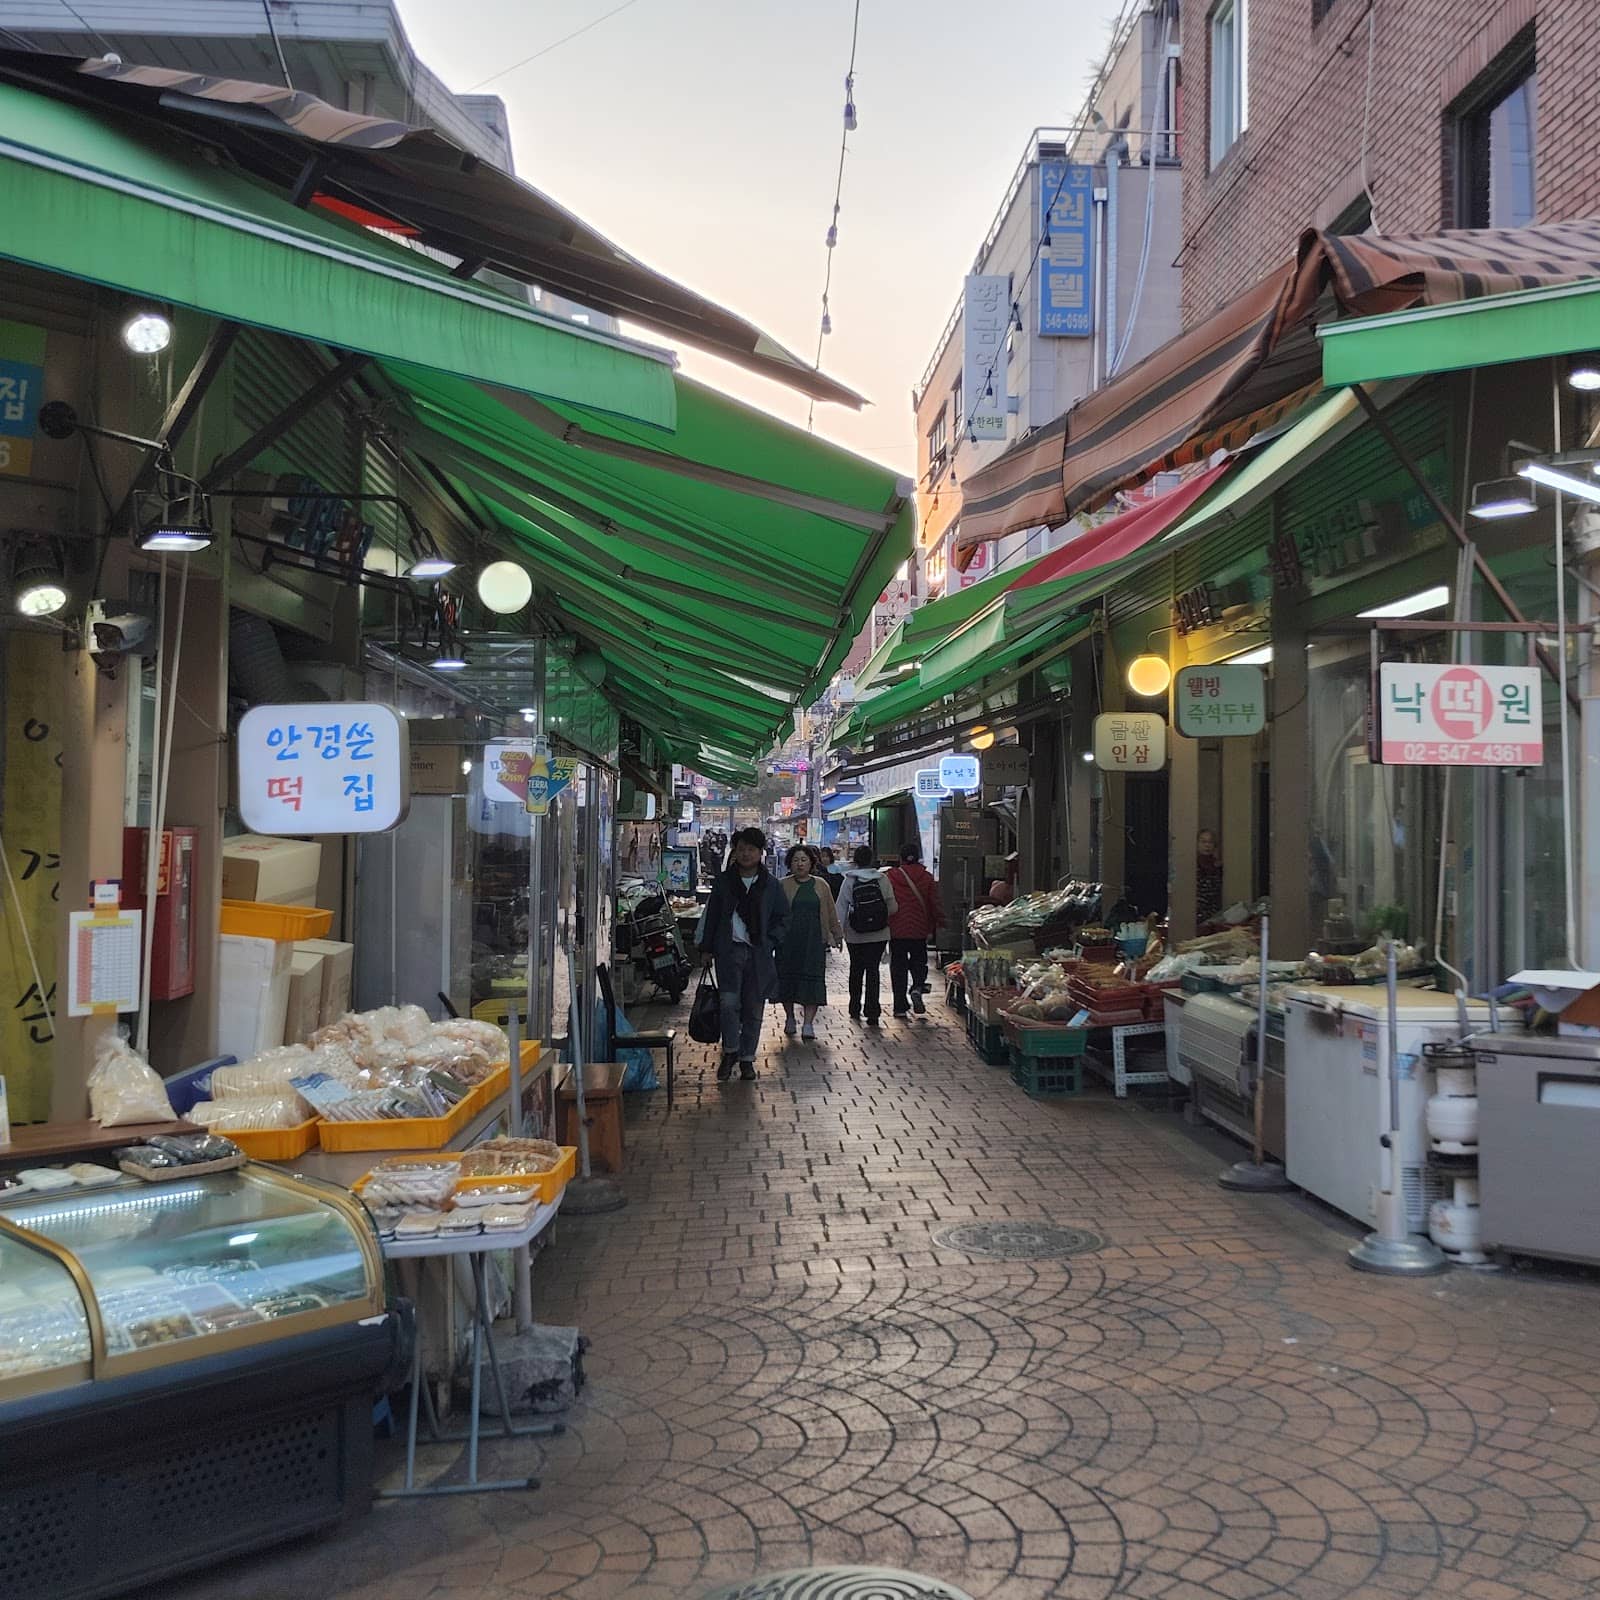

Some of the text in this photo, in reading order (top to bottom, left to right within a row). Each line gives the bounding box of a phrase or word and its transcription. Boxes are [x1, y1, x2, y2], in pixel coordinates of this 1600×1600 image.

[1048, 192, 1085, 309] 원룸텔
[1186, 676, 1221, 697] 웰빙
[1187, 703, 1257, 724] 즉석두부
[1391, 678, 1531, 735] 낙 떡 원
[1110, 720, 1152, 740] 금산
[266, 722, 375, 760] 안경쓴
[1111, 744, 1151, 764] 인삼
[1403, 743, 1523, 762] 02-547-4361
[267, 774, 375, 811] 떡 집
[528, 779, 548, 789] TERRA
